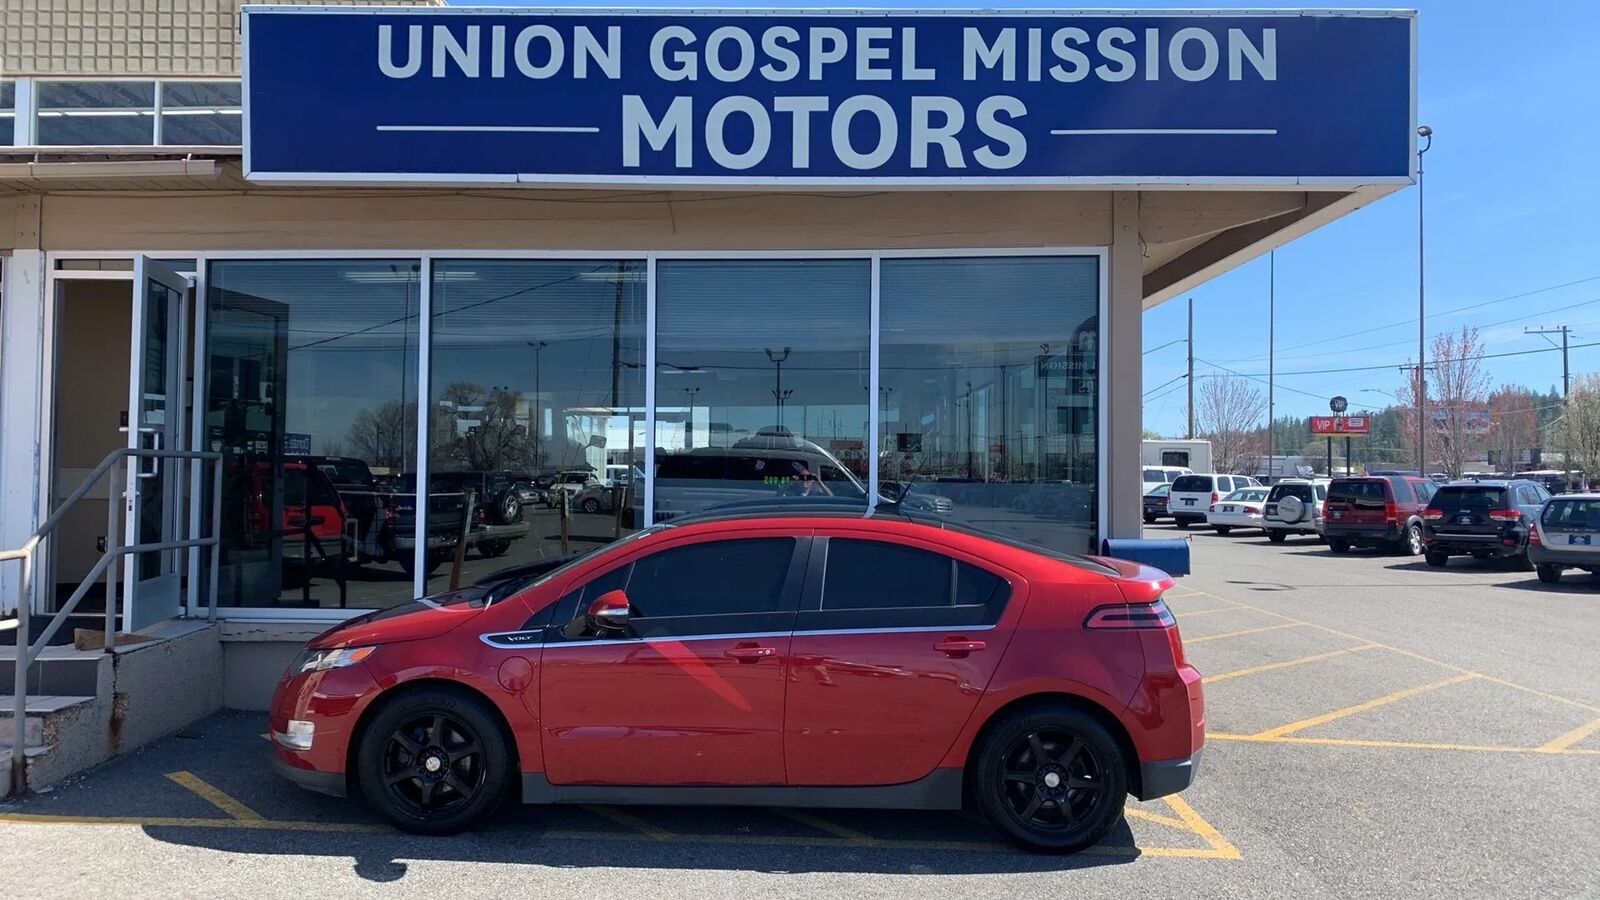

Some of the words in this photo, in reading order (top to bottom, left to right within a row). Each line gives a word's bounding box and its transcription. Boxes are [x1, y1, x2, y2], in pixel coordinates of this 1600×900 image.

[377, 24, 622, 79] UNION
[649, 25, 936, 83] GOSPEL
[963, 27, 1278, 83] MISSION
[621, 94, 1029, 171] MOTORS
[1316, 420, 1330, 430] VIP
